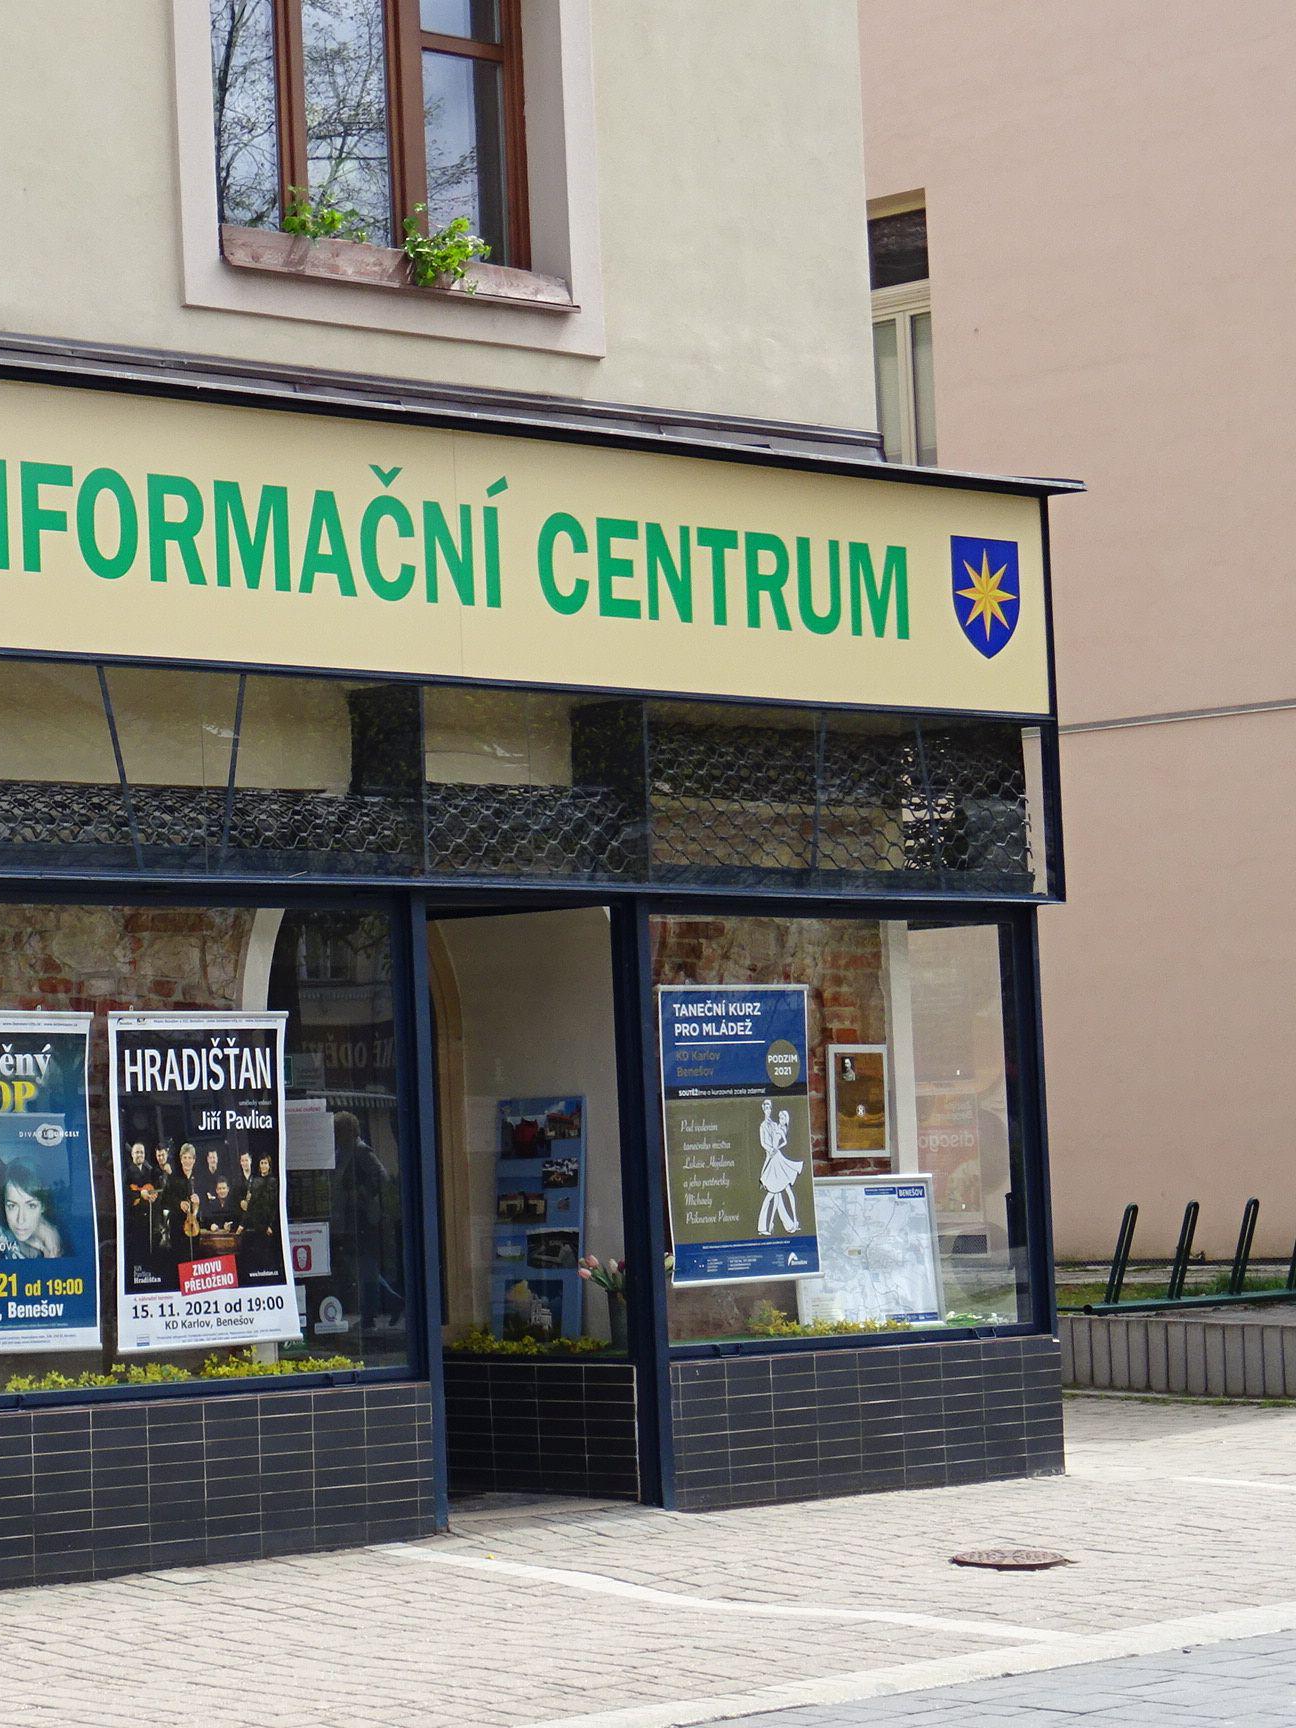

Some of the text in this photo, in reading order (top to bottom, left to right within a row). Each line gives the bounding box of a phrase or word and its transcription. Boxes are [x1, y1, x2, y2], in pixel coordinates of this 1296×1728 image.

[537, 512, 911, 640] CENTRUM
[672, 1000, 762, 1017] TANEČNÍ KURZ
[674, 1019, 753, 1037] PRO MLÁDEŽ
[124, 1037, 272, 1092] HRADIŠŤAN
[676, 1050, 721, 1061] KD Karlov
[767, 1054, 798, 1064] PODZIM
[677, 1066, 714, 1077] Benešov
[774, 1066, 792, 1076] 2021
[198, 1109, 273, 1131] Jiří Pavlica
[191, 1259, 222, 1277] ZNOVU
[24, 1280, 42, 1297] od
[46, 1278, 84, 1296] 19:00
[184, 1272, 234, 1293] PŘELOŽENO
[7, 1299, 64, 1319] Benešov
[132, 1295, 284, 1320] 15. 11. 2021 od 19:00
[165, 1315, 255, 1331] KD Karlov, Benešov
